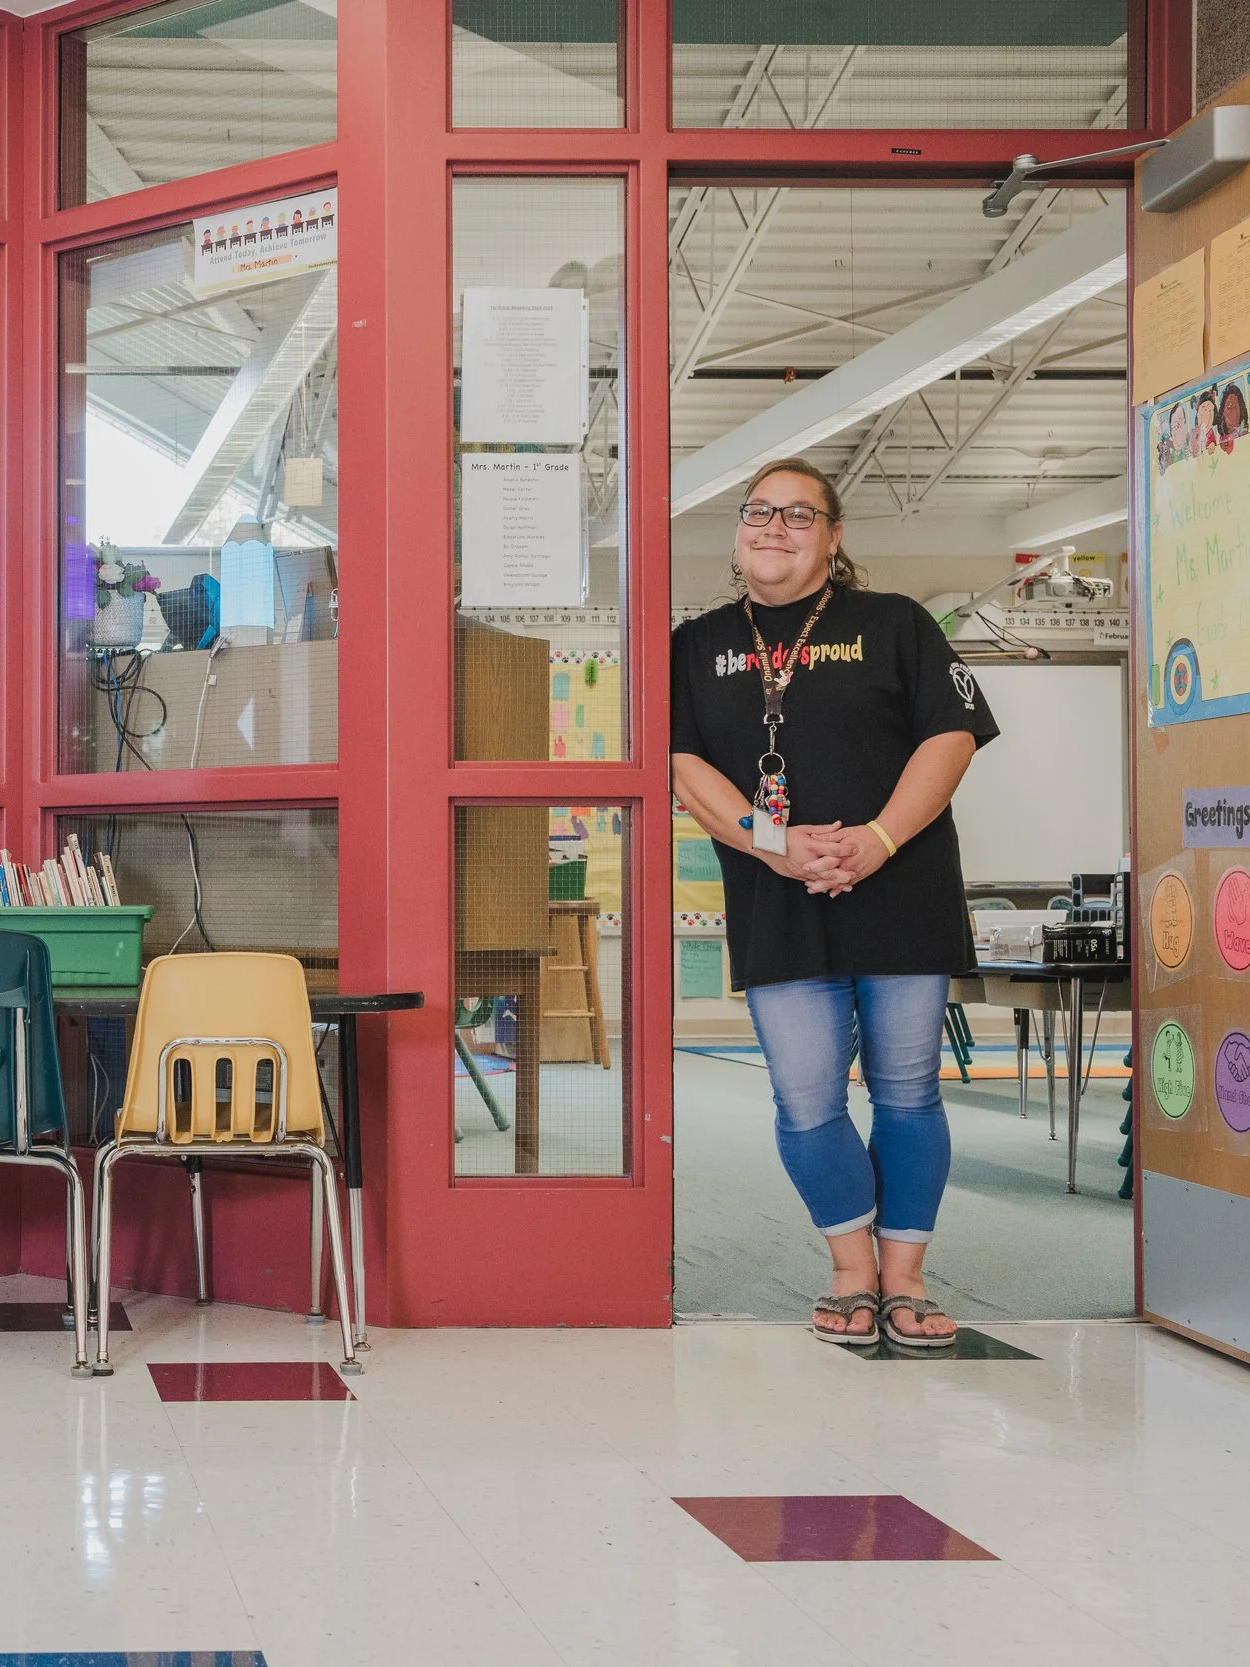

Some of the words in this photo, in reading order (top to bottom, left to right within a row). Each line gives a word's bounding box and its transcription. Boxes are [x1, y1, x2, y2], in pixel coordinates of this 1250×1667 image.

[209, 253, 232, 265] Attend
[234, 247, 258, 261] Today,
[260, 242, 288, 254] Achieve
[290, 234, 327, 247] Tomorrow
[254, 257, 278, 269] Martin
[471, 463, 490, 471] Mrs.
[493, 463, 521, 471] Martin
[544, 463, 569, 471] Grade
[1169, 480, 1233, 528] Welcome
[1072, 554, 1096, 563] yellow
[484, 614, 495, 623] 104
[500, 614, 511, 623] 105
[515, 614, 526, 623] 106
[529, 614, 539, 623] 107
[543, 614, 554, 623] 108
[561, 614, 571, 623] 109
[575, 615, 586, 623] 110
[591, 615, 600, 623] 111
[606, 615, 617, 624] 112
[799, 615, 820, 639] Expect
[1005, 617, 1015, 625] 133
[1020, 617, 1030, 626] 134
[1035, 618, 1046, 626] 135
[1050, 618, 1061, 626] 136
[1065, 618, 1076, 627] 137
[1079, 618, 1090, 627] 138
[1094, 618, 1105, 627] 139
[1109, 618, 1121, 627] 140
[1105, 632, 1129, 640] Februa
[760, 652, 773, 682] Onamia
[783, 638, 806, 679] Excellenc
[1185, 799, 1250, 840] Greetings
[1162, 930, 1180, 958] Hug
[1156, 1076, 1173, 1100] High
[1175, 1079, 1191, 1098] Five
